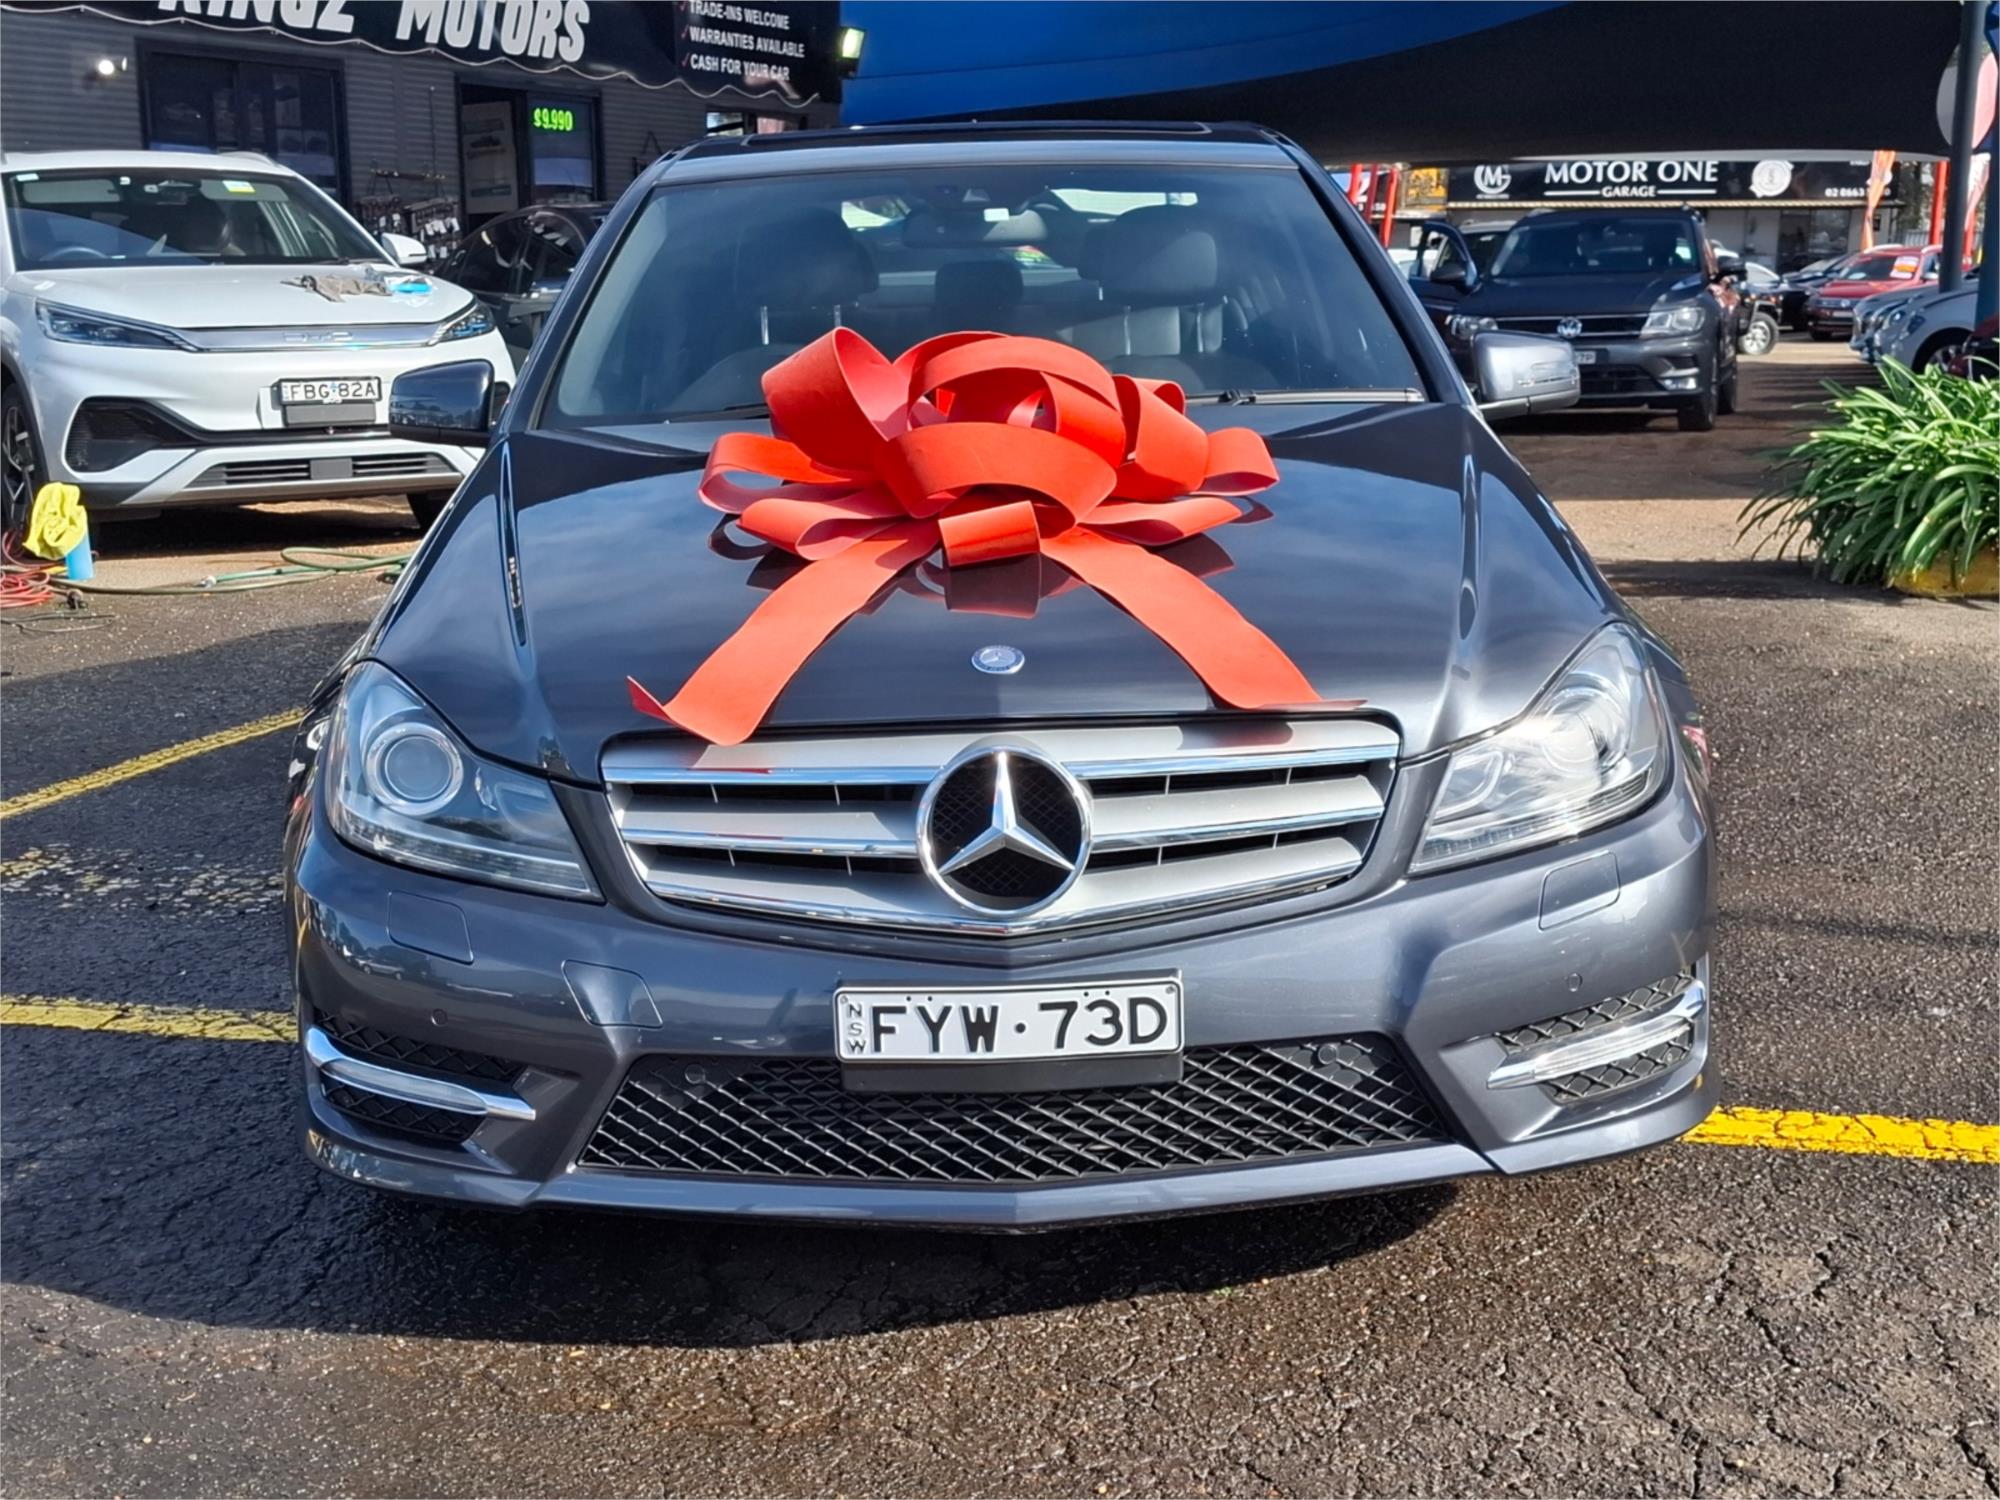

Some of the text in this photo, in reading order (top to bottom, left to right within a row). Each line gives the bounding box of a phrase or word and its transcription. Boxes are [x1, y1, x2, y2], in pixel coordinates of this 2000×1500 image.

[690, 0, 790, 30] TRADE-INS WELCOME
[395, 0, 590, 62] MOTORS
[689, 26, 805, 58] WARRANTIES AVAILABLE
[690, 54, 790, 81] CASH FOR YOUR CAR
[1544, 161, 1719, 184] MOTOR ONE
[1602, 185, 1656, 198] GARAGE
[847, 1003, 867, 1054] NSW
